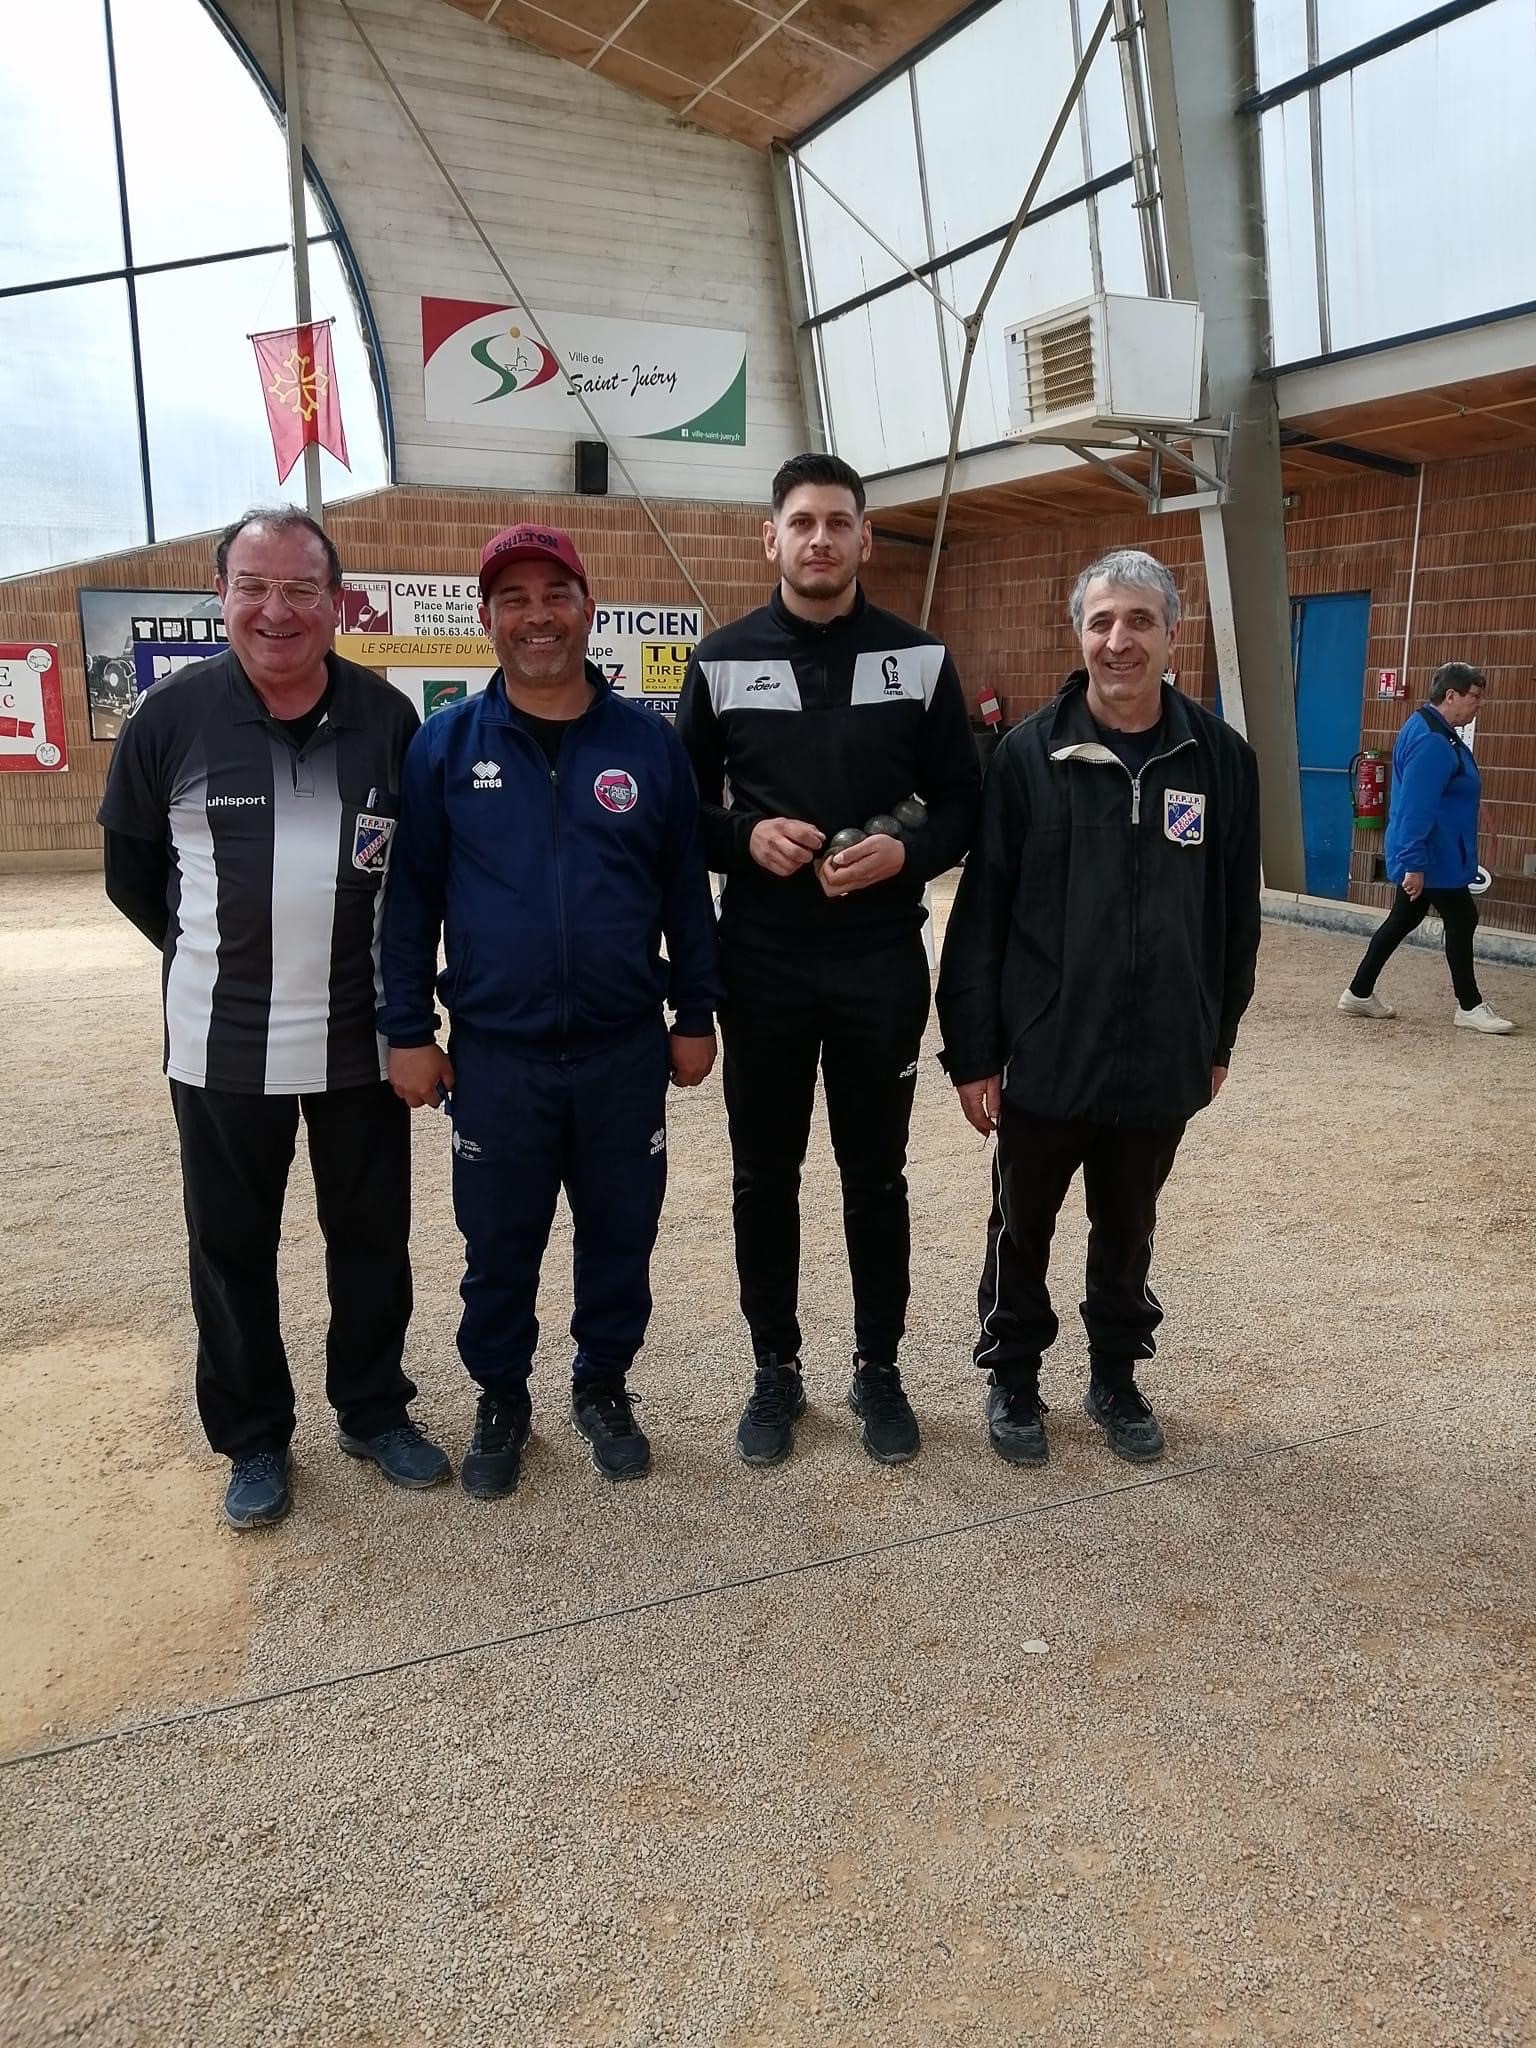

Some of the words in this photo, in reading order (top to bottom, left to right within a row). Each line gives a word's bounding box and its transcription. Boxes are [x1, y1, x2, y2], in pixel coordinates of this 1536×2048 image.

[569, 352, 589, 362] Ville
[592, 355, 604, 364] de
[567, 364, 677, 397] Saint-Juéry
[494, 532, 559, 553] SHILTON
[352, 583, 387, 591] CELLIER
[395, 583, 437, 597] CAVE
[443, 585, 461, 597] LE
[414, 601, 442, 610] Place
[446, 601, 473, 610] Marie
[414, 614, 444, 623] 81160
[447, 614, 473, 623] Saint
[415, 626, 430, 635] Tél
[434, 627, 487, 636] 05.63.45.0
[361, 642, 375, 653] LE
[378, 643, 452, 653] SPECIALISTE
[456, 644, 472, 653] DU
[473, 779, 502, 789] errea
[207, 795, 267, 808] uhlsport
